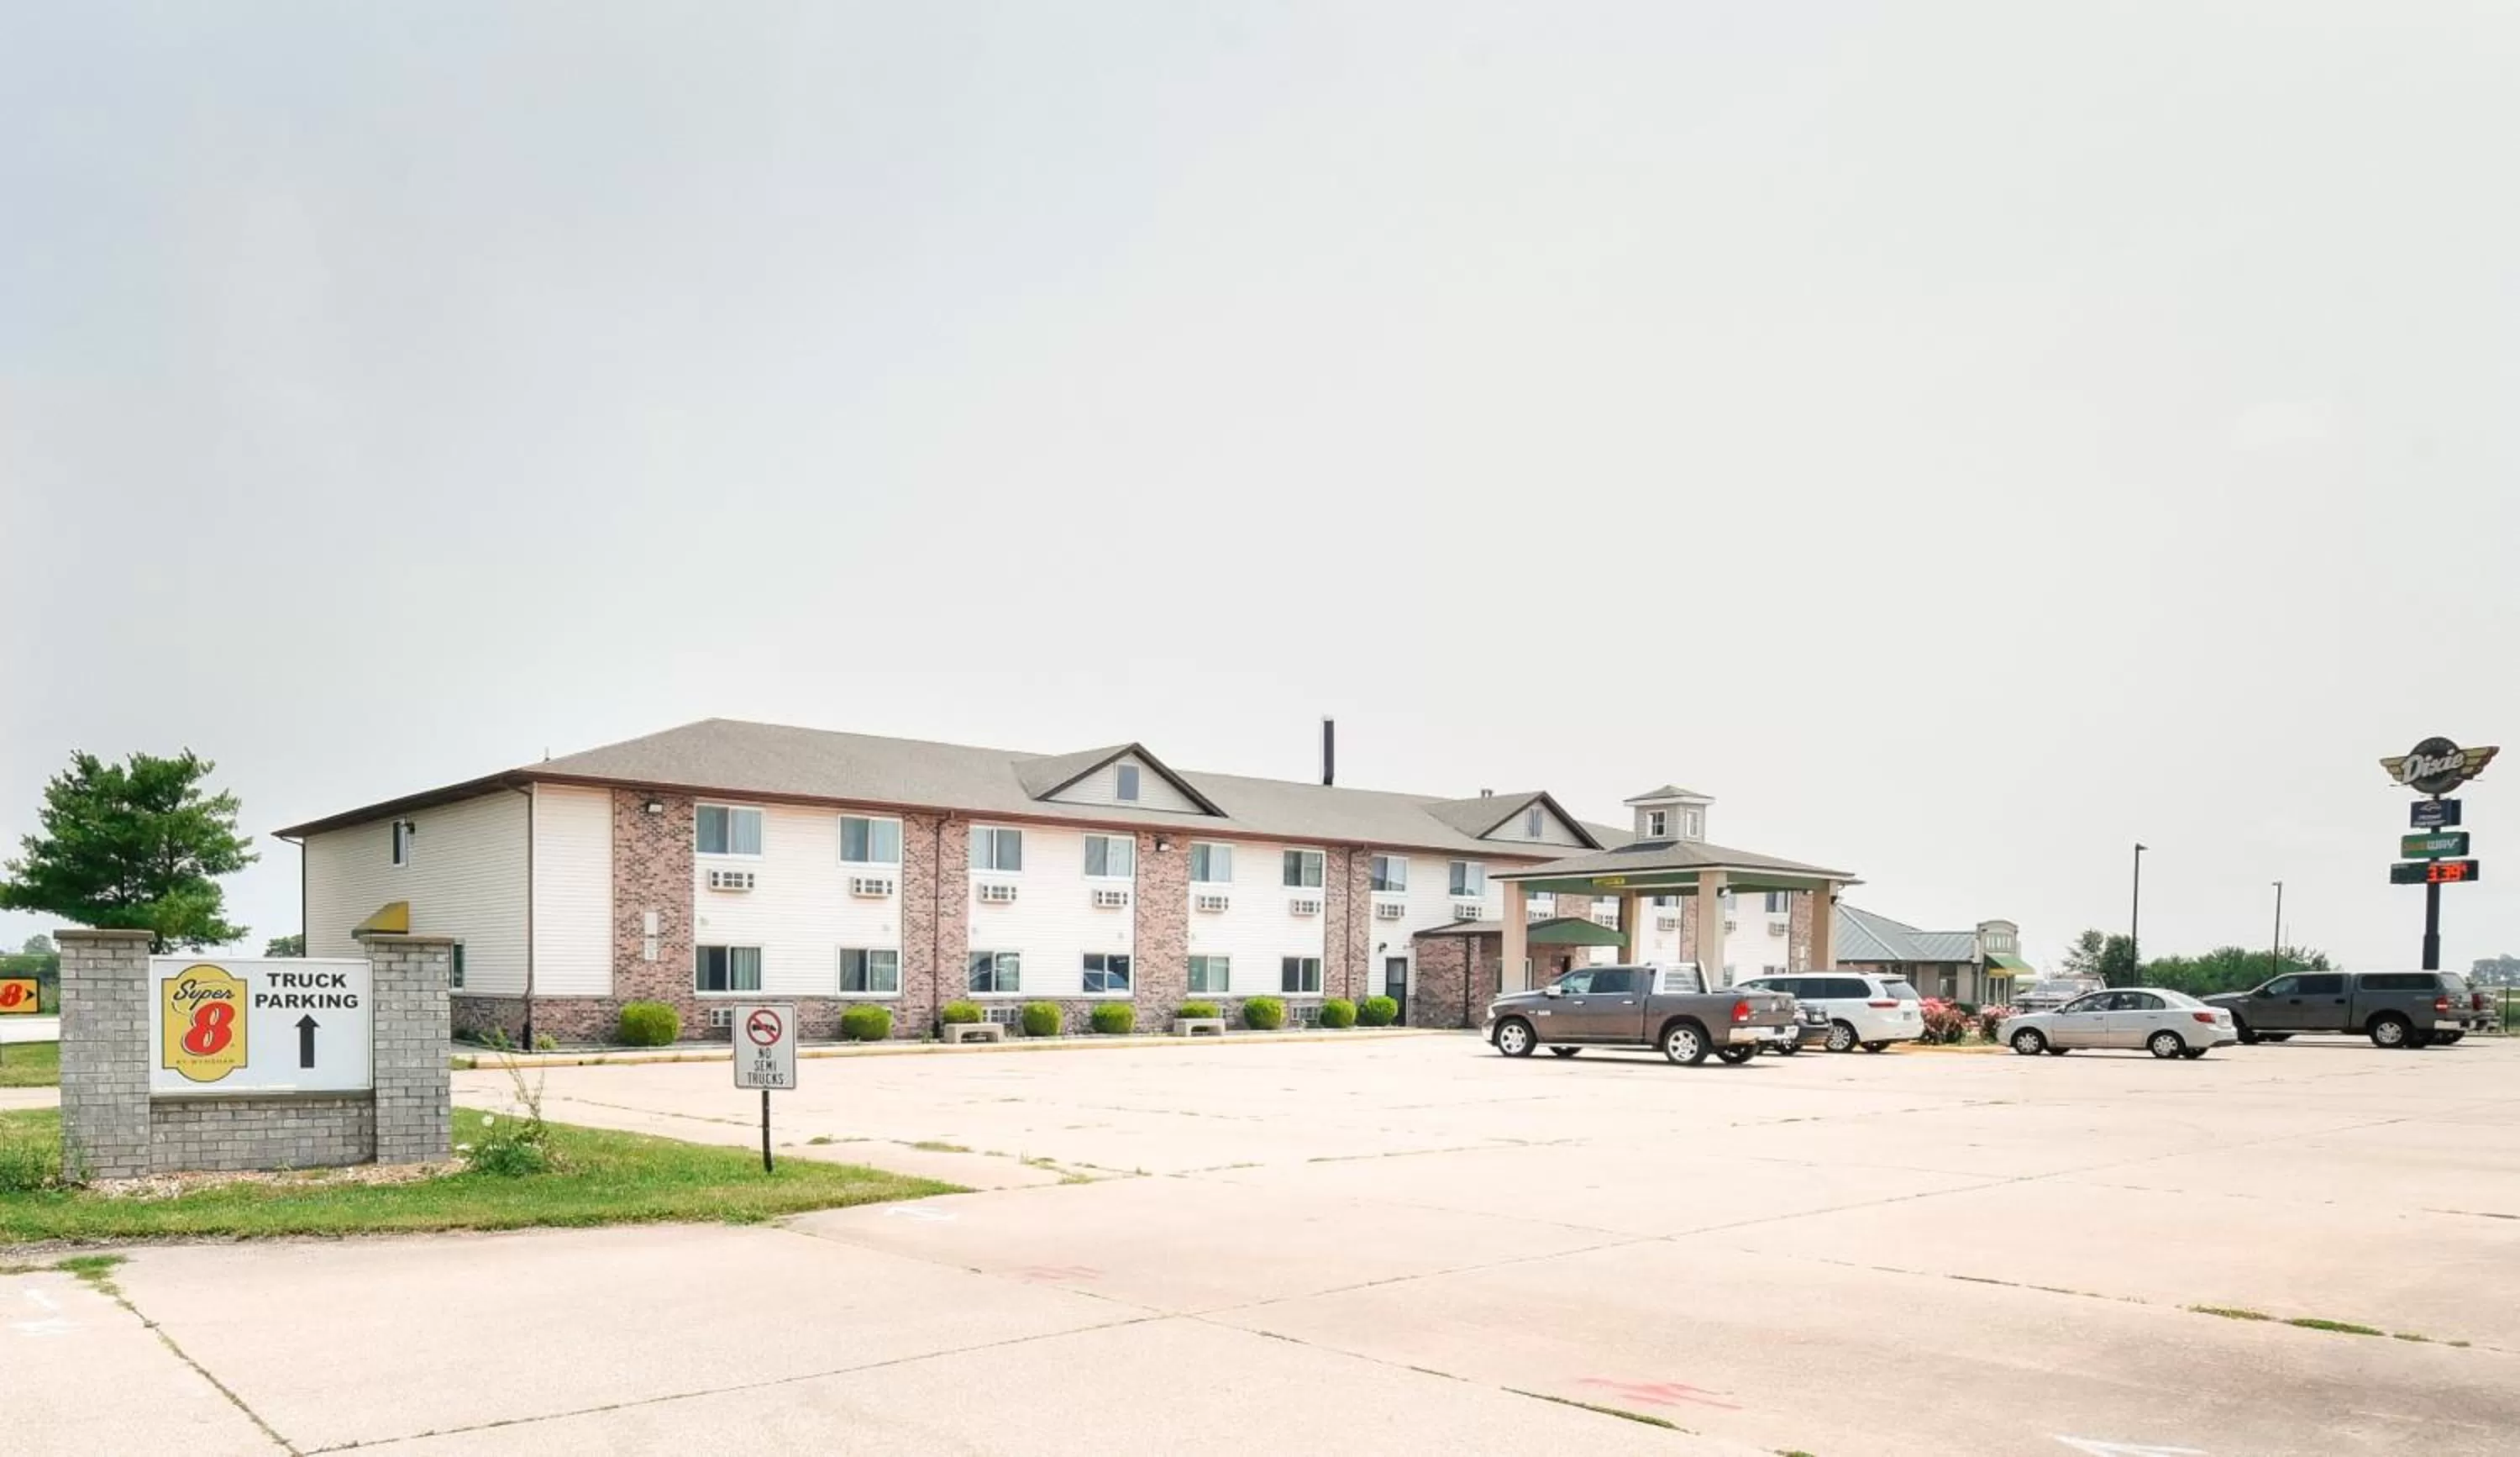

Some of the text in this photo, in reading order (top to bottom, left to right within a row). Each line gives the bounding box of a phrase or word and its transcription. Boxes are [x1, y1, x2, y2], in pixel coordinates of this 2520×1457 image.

[2402, 749, 2464, 783] Dixie
[2403, 838, 2459, 851] WAY
[266, 972, 347, 988] TRUCK
[0, 982, 24, 1007] 8
[173, 979, 234, 1011] Super
[255, 993, 359, 1009] PARKING
[181, 1002, 235, 1056] 8
[759, 1048, 772, 1059] NO
[754, 1060, 777, 1072] SEMI
[748, 1071, 784, 1085] TRUCKS
